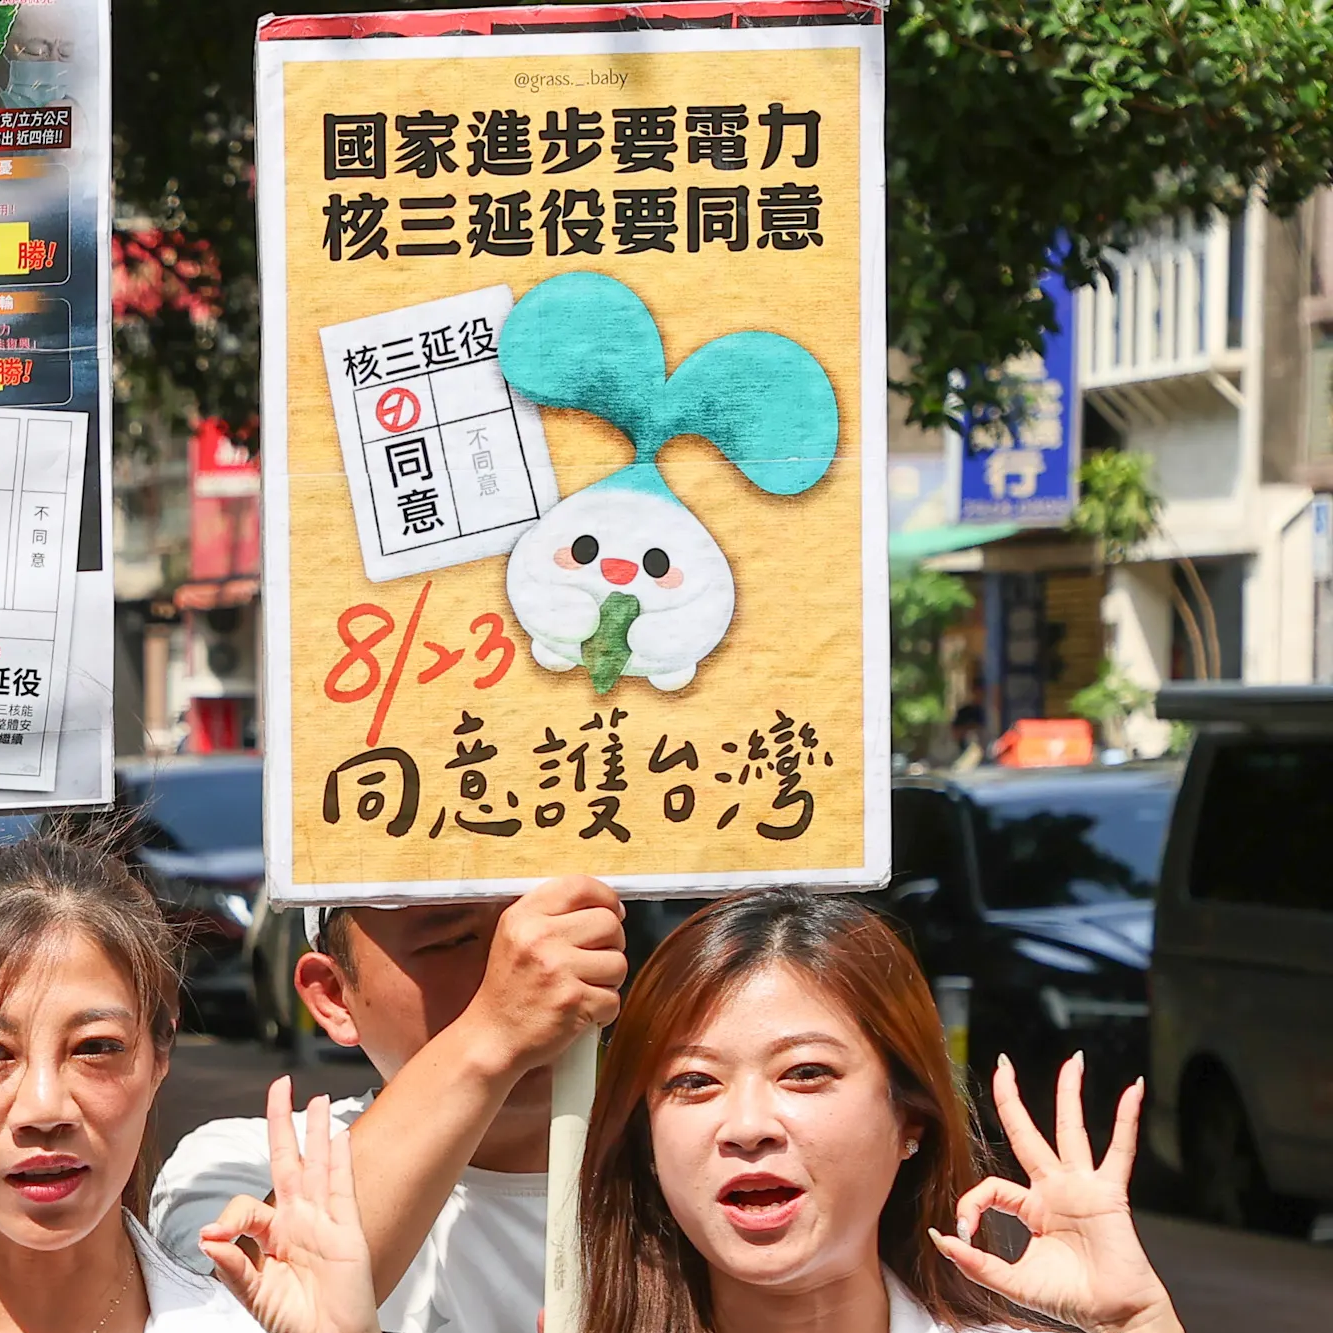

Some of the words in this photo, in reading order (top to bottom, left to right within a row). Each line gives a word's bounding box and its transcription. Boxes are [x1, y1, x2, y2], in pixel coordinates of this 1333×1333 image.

[514, 68, 628, 93] @grass._.baby
[16, 129, 63, 145] 近四倍!!
[322, 102, 823, 180] 國家進步要電力
[18, 240, 56, 270] 勝!
[321, 183, 825, 262] 核三延役要同意
[342, 318, 501, 382] 核三延役
[383, 439, 447, 538] 同意
[467, 426, 502, 499] 不同意
[31, 505, 50, 568] 不同意
[324, 580, 516, 747] 8/23
[324, 707, 834, 843] 同意護台灣
